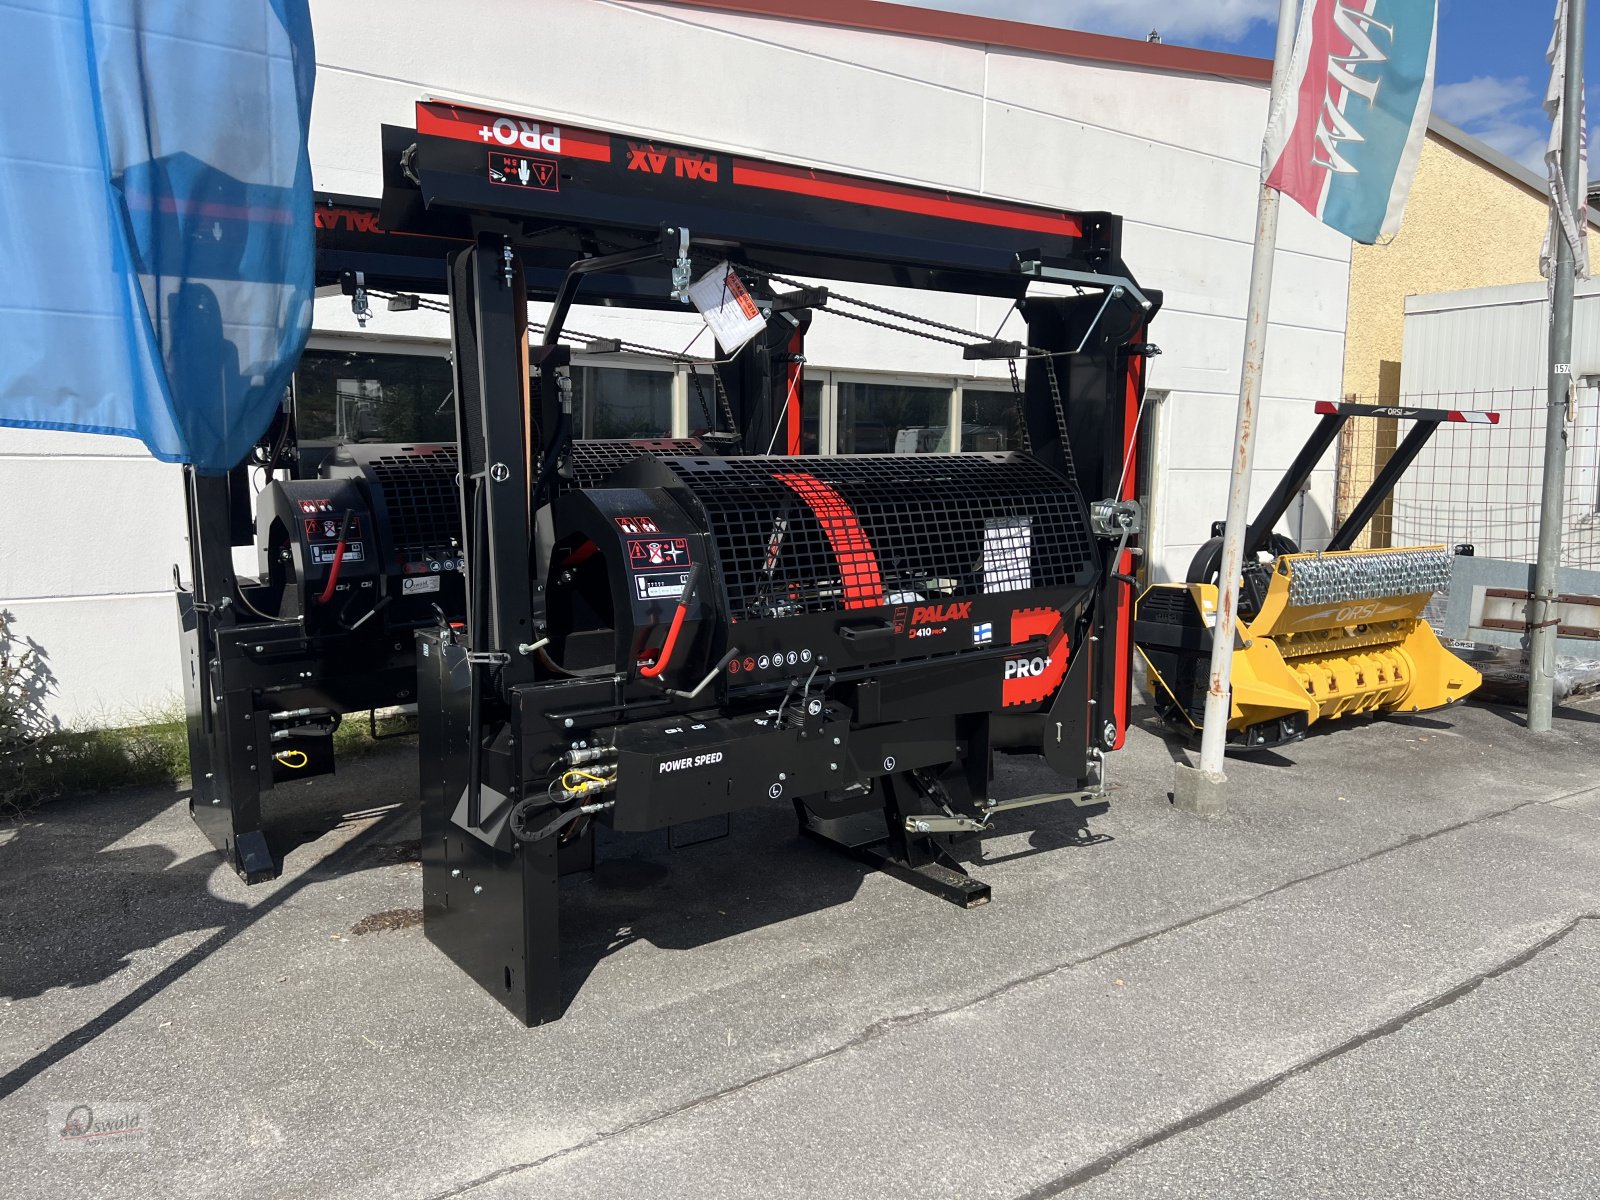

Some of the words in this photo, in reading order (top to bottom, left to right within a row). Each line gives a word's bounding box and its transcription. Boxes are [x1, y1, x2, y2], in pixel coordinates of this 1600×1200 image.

[478, 117, 561, 153] PRO+
[627, 142, 718, 183] PALAX
[1387, 407, 1403, 416] ORSI
[910, 602, 972, 625] PALAX
[1335, 602, 1379, 622] ORSI
[1004, 656, 1052, 680] PRO+
[659, 756, 692, 774] POWER
[694, 751, 723, 767] SPEED
